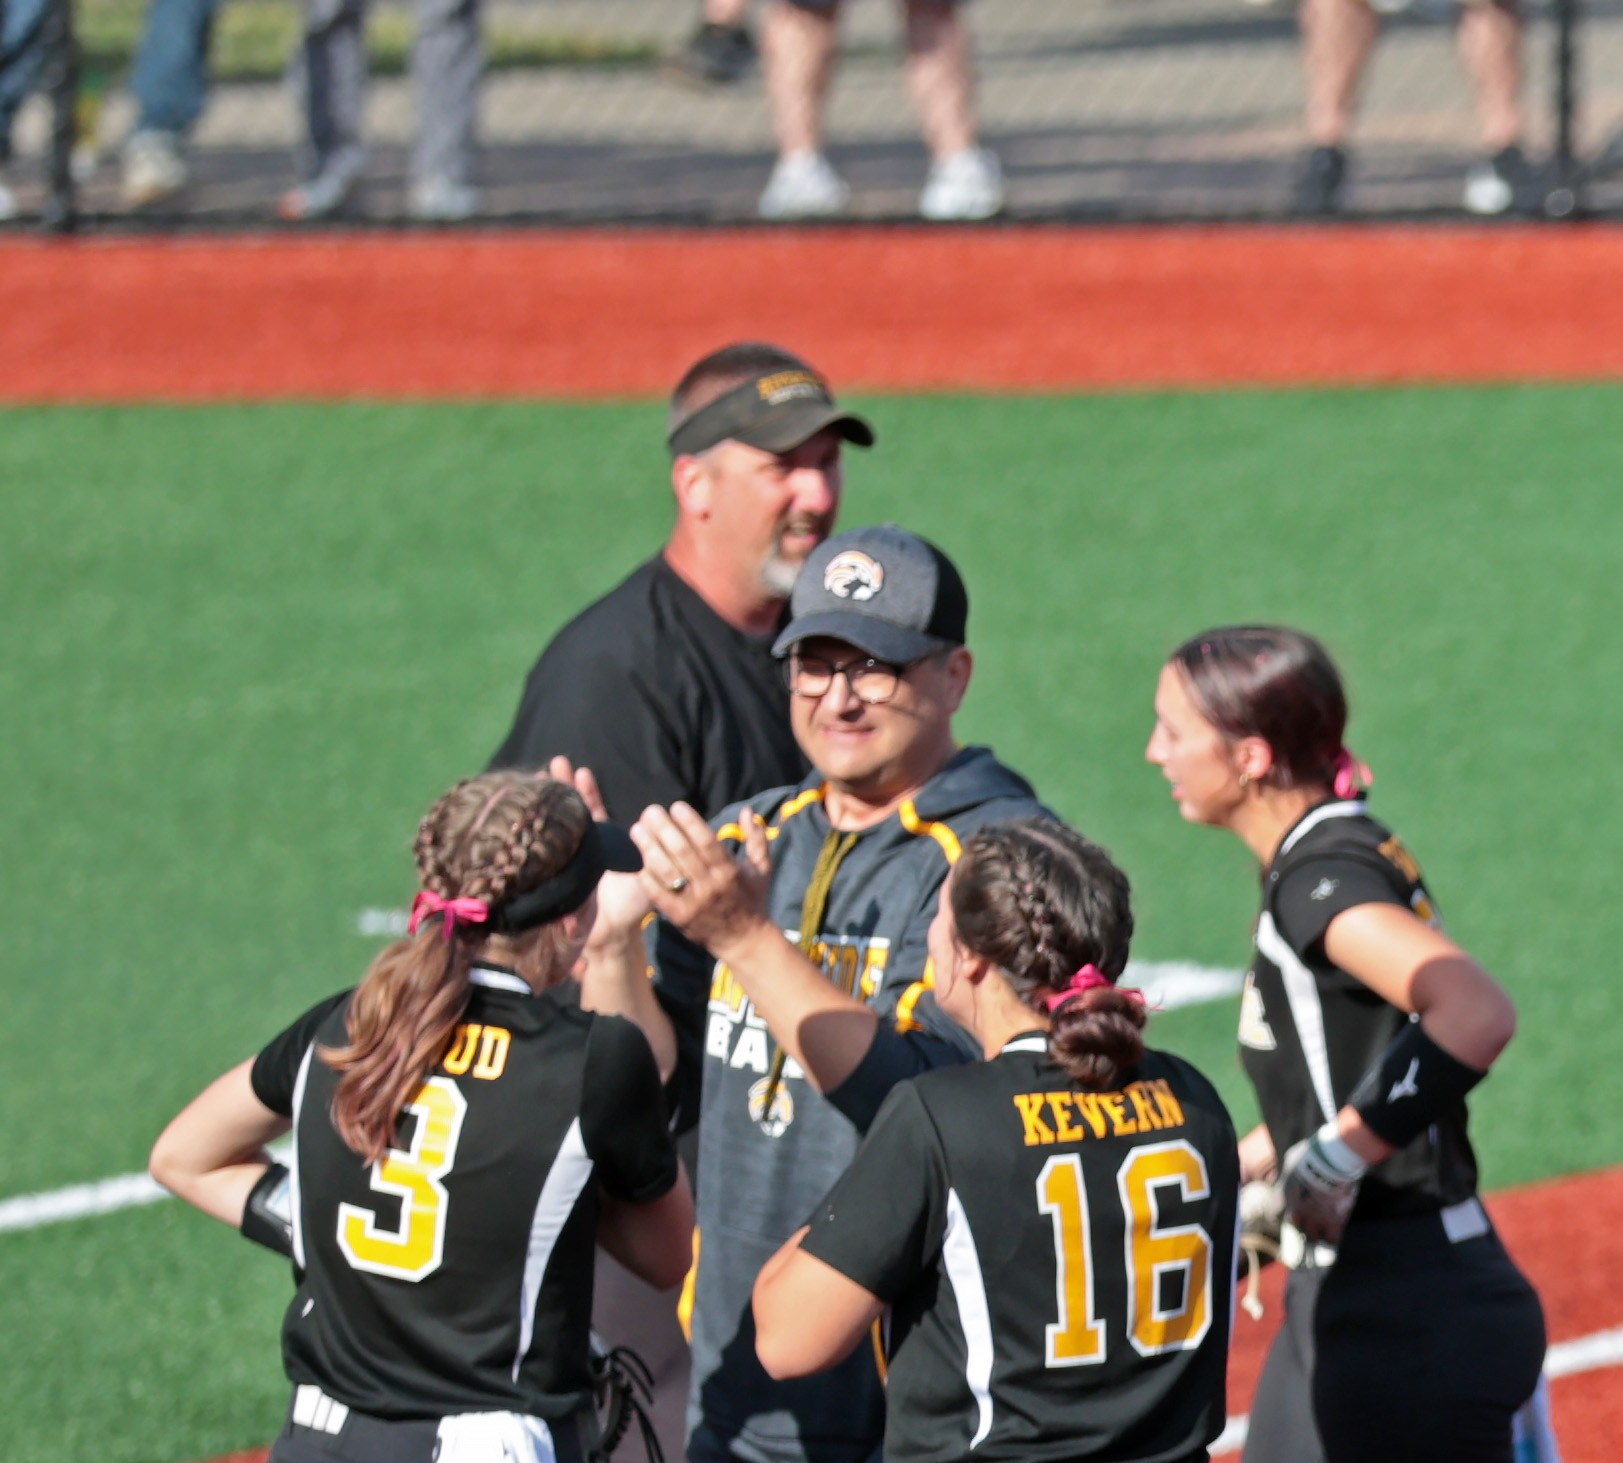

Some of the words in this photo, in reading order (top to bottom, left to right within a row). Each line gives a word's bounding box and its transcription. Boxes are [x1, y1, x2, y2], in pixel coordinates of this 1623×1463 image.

[336, 1074, 468, 1283] 3
[1013, 1079, 1186, 1146] KEVERN
[1035, 1138, 1214, 1369] 16
